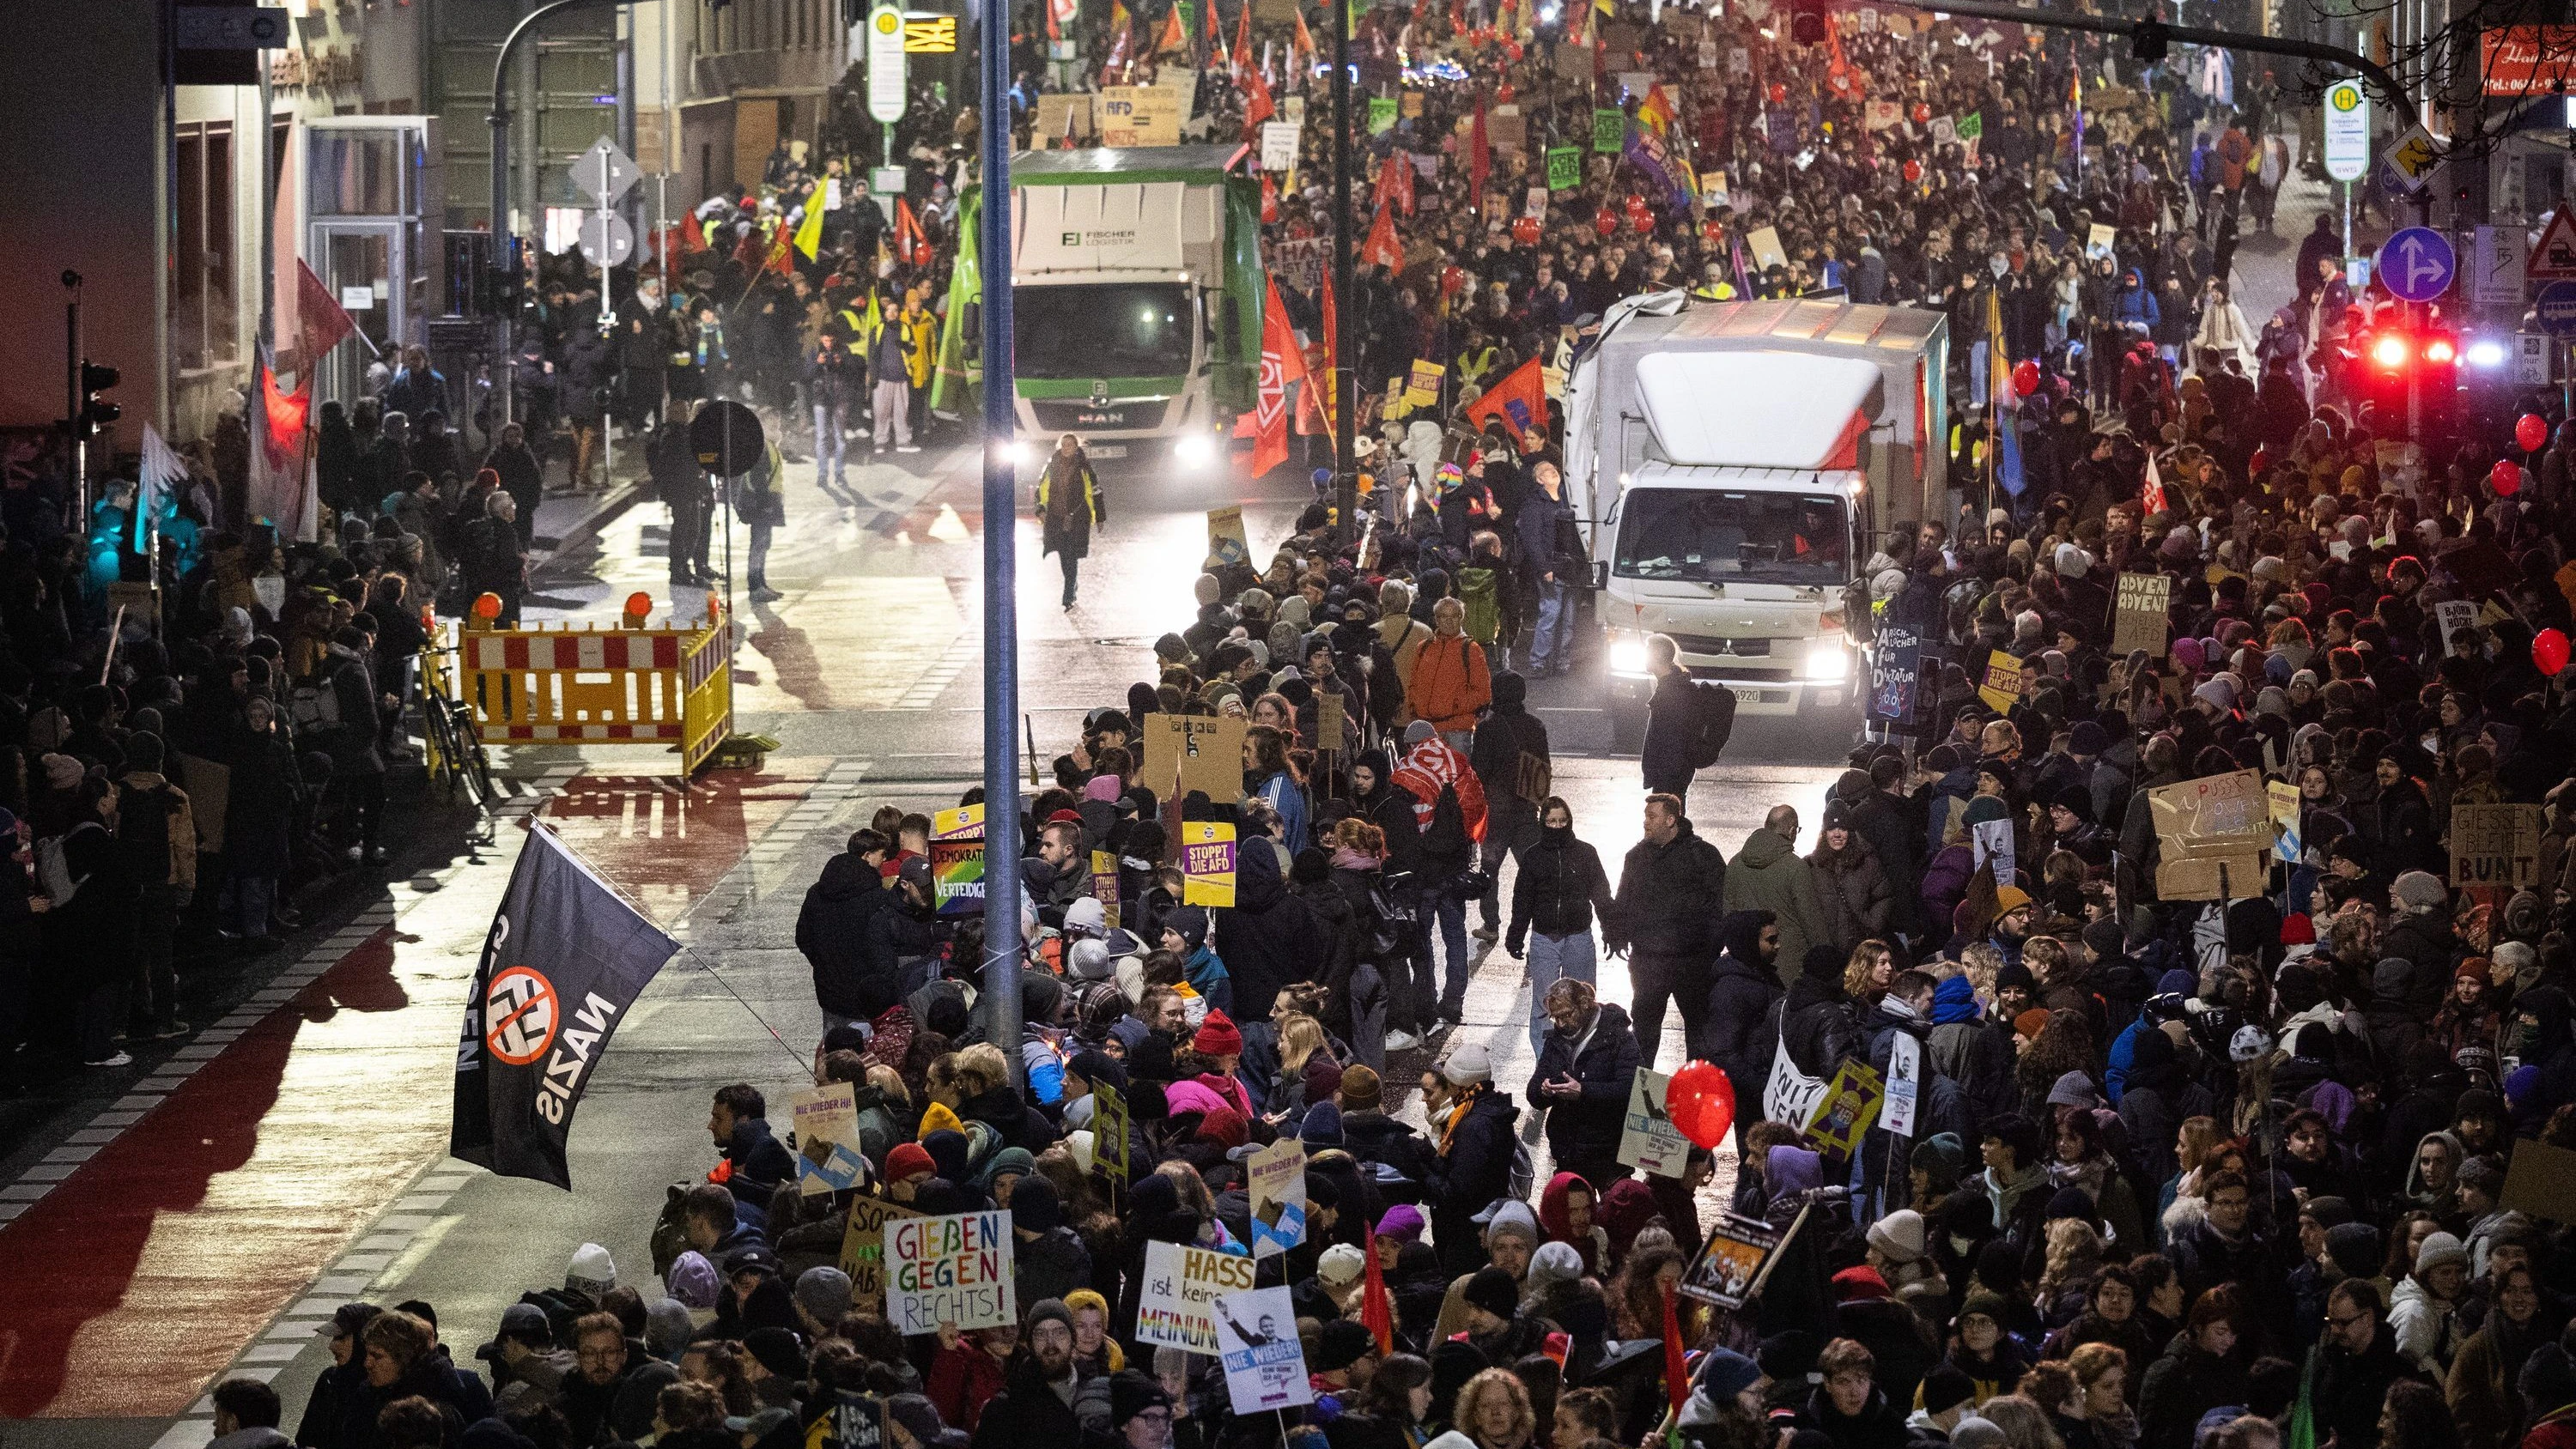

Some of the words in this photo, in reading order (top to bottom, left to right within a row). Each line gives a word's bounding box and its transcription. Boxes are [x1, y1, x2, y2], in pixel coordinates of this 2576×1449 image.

[2340, 91, 2351, 106] H
[1106, 100, 1133, 117] AFD
[1551, 163, 1579, 179] AFD
[1086, 230, 1135, 239] FISCHER
[1086, 238, 1135, 246] LOGISTIK
[1078, 413, 1123, 423] MAN
[2119, 576, 2171, 595] ADVENT
[2117, 592, 2169, 612] ADVENT
[2445, 603, 2471, 617] BJÖRN
[2447, 615, 2473, 628] HÖCKE
[1874, 668, 1915, 688] DIKTATUR
[1988, 678, 2003, 688] DIE
[2003, 681, 2021, 694] AFD
[2458, 808, 2539, 830] GIESSEN
[2466, 831, 2526, 852] BLEIBT
[1189, 845, 1228, 860] STOPPT
[1190, 859, 1207, 874] DIE
[1208, 858, 1230, 872] AFD
[2459, 856, 2534, 882] BUNT
[1095, 876, 1117, 889] STOPPT
[1096, 889, 1106, 901] DIE
[1106, 888, 1117, 901] AFD
[796, 1105, 807, 1115] NIE
[810, 1099, 839, 1113] WIEDER
[841, 1098, 852, 1109] HJ!
[1252, 1167, 1264, 1178] NIE
[1265, 1159, 1291, 1173] WIEDER
[898, 1250, 998, 1292] GEGEN
[1184, 1250, 1255, 1290] HASS
[1151, 1276, 1172, 1297] ist
[904, 1285, 1005, 1330] RECHTS!
[1139, 1307, 1220, 1350] MEINUN
[1225, 1353, 1249, 1372] NIE
[1250, 1341, 1301, 1364] WIEDER!
